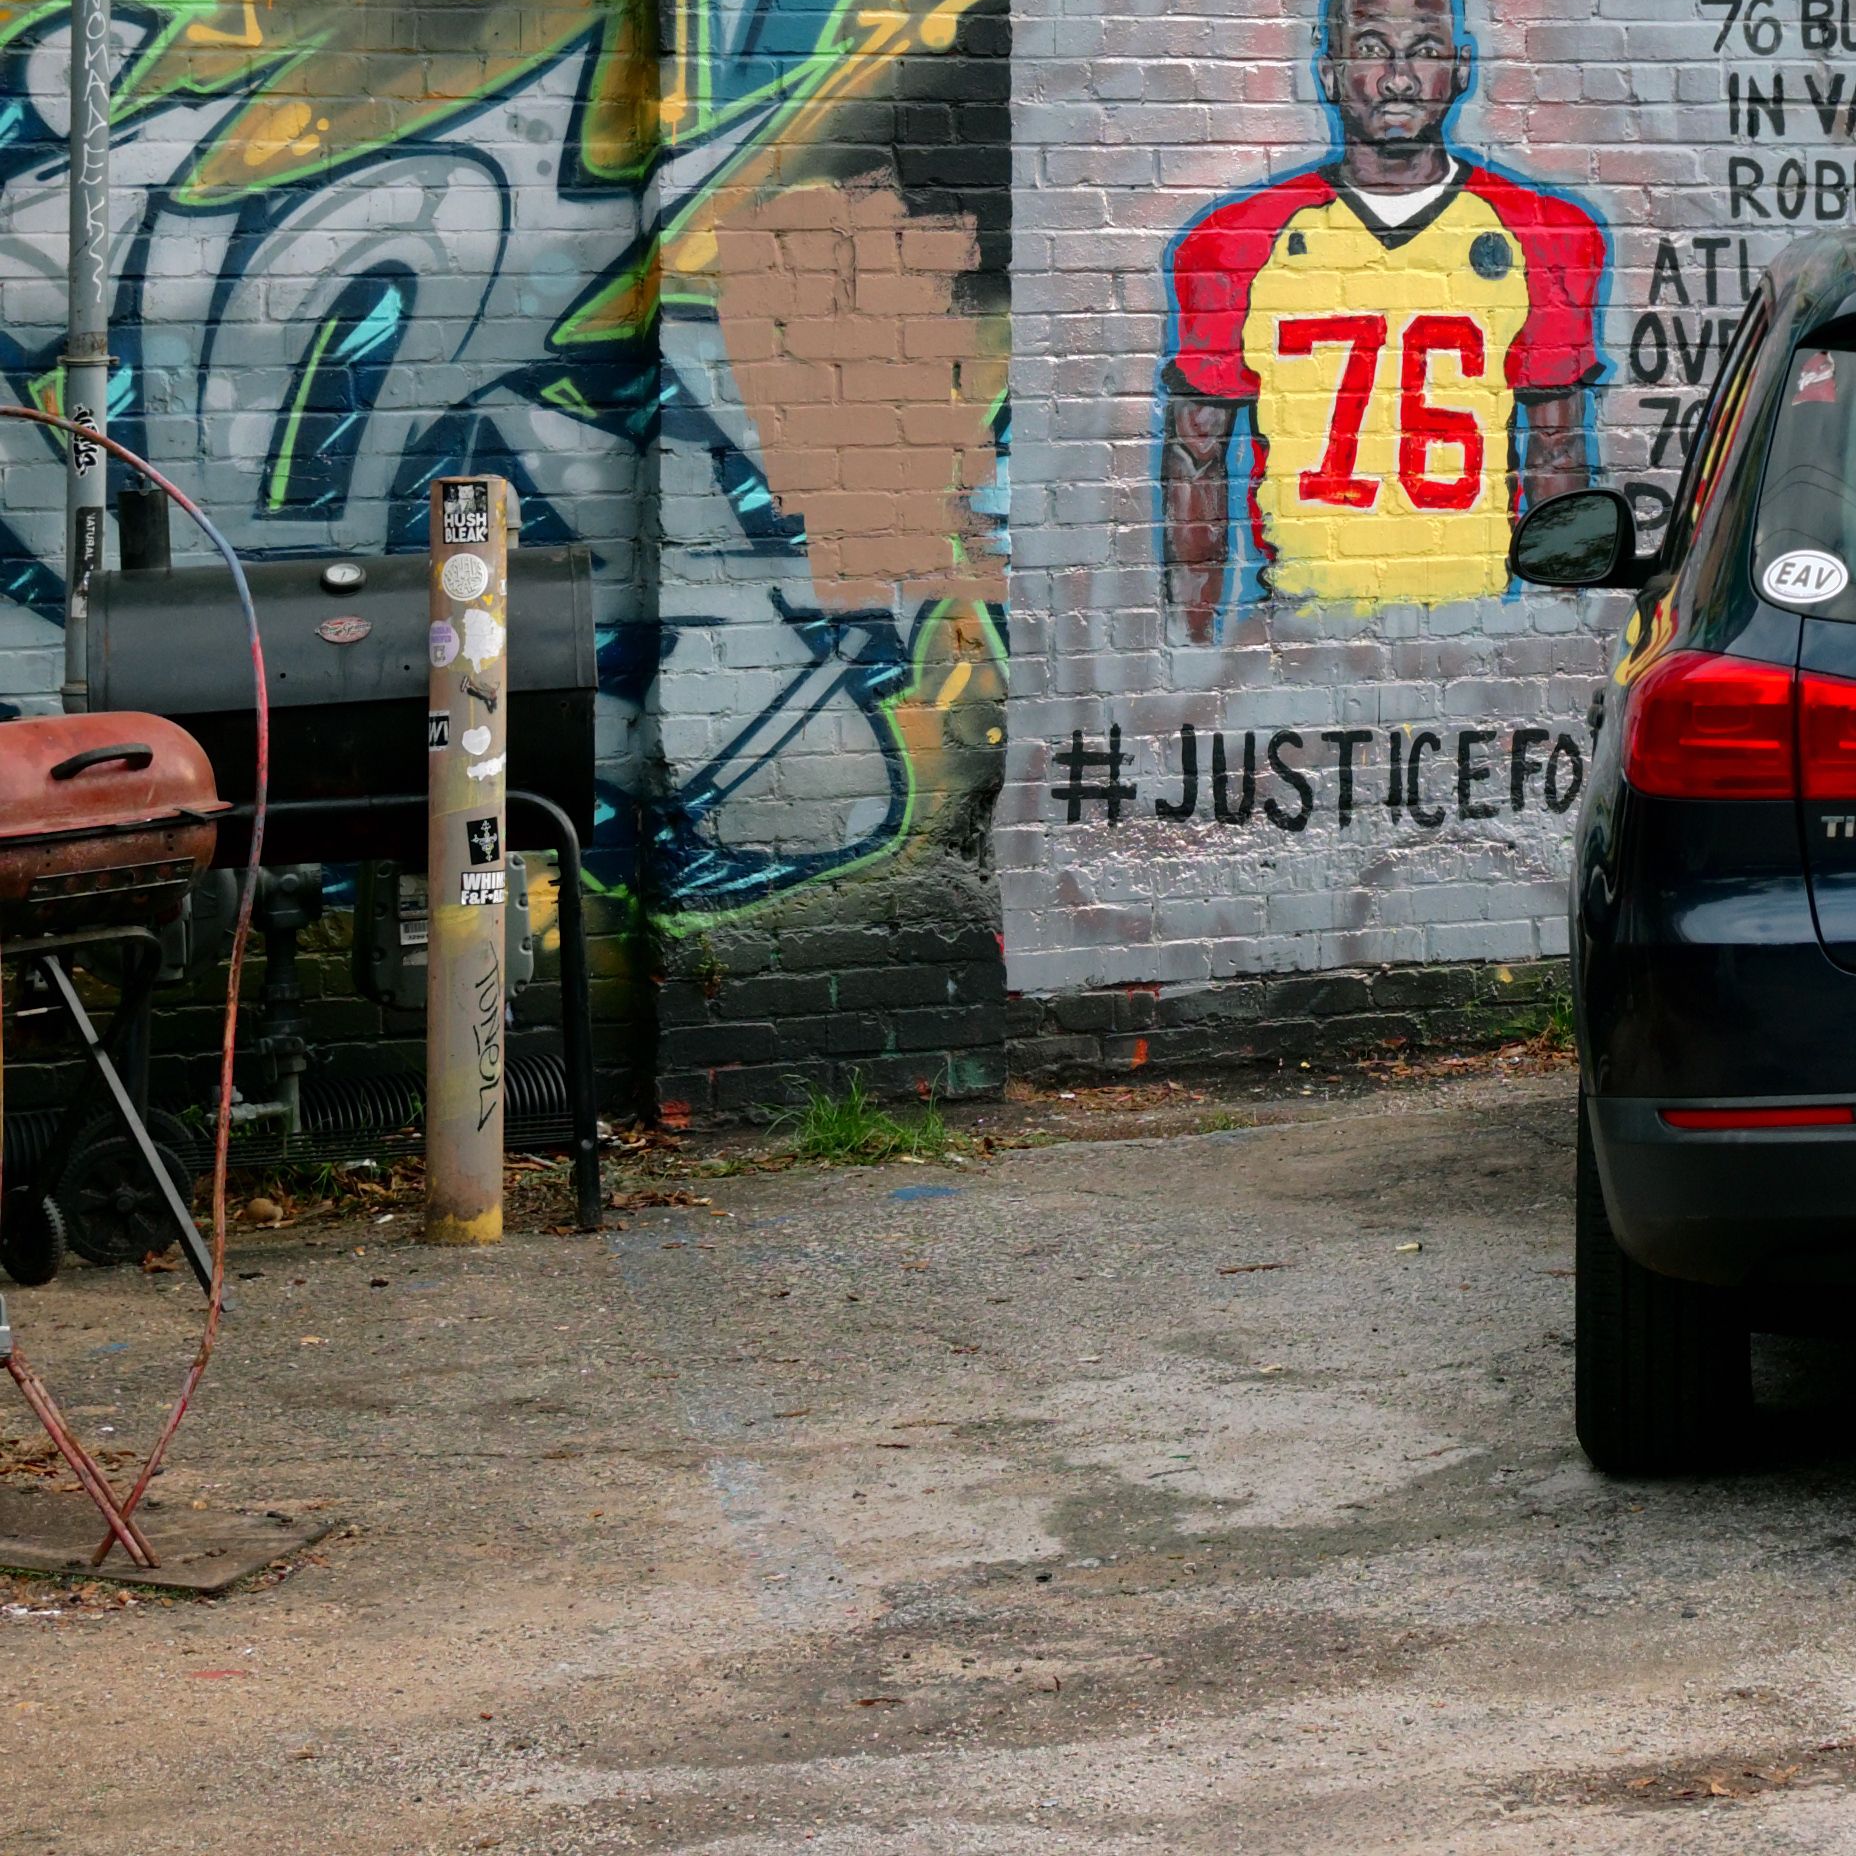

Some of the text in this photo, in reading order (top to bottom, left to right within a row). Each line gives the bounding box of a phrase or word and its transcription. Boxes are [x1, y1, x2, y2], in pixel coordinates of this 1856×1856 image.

[1728, 71, 1785, 139] IN
[1275, 313, 1487, 512] 76
[444, 512, 487, 528] HUSH
[1775, 562, 1835, 590] EAV
